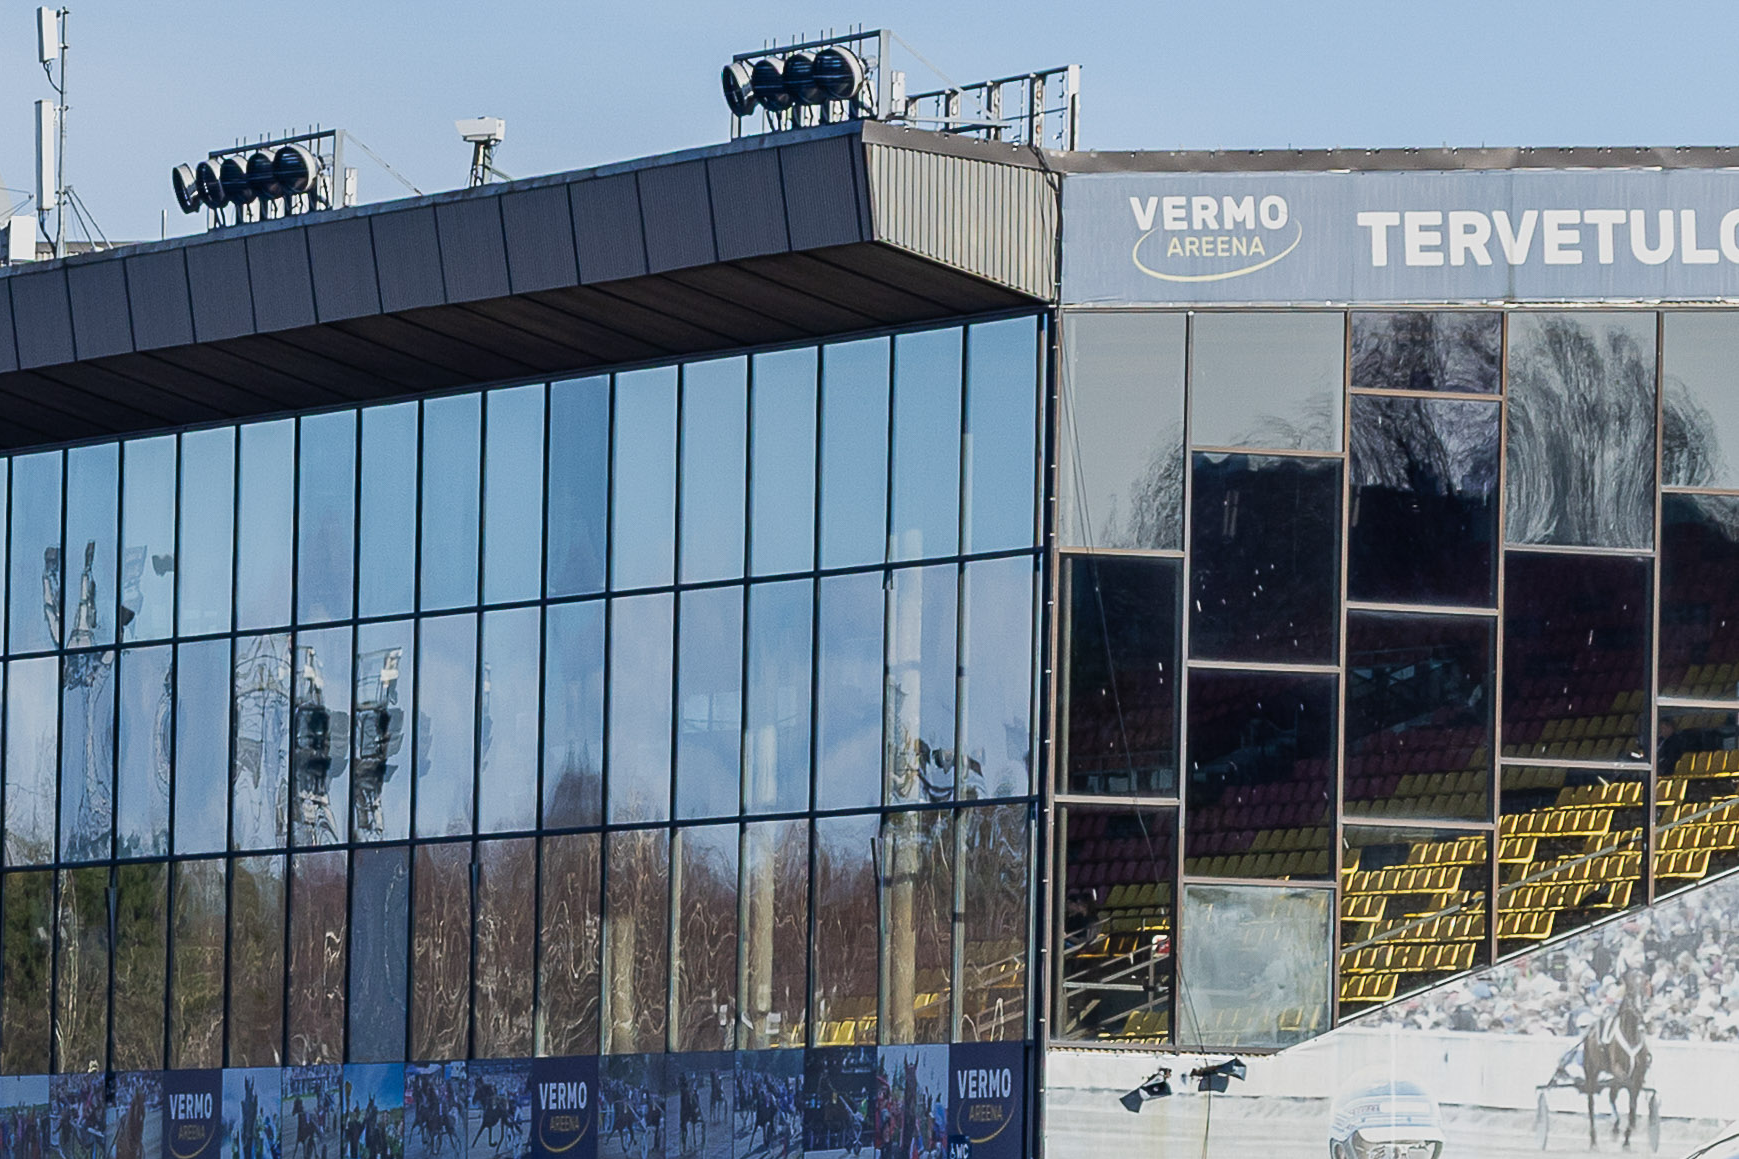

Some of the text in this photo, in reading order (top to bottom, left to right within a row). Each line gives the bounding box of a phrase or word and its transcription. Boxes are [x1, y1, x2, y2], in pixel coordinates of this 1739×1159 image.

[1129, 194, 1290, 231] VERMO
[1167, 235, 1266, 258] AREENA
[539, 1081, 588, 1110] VERMO
[957, 1068, 1012, 1099] VERMO
[168, 1092, 213, 1120] VERMO
[968, 1103, 1004, 1121] AREENA
[956, 1142, 969, 1159] WC
